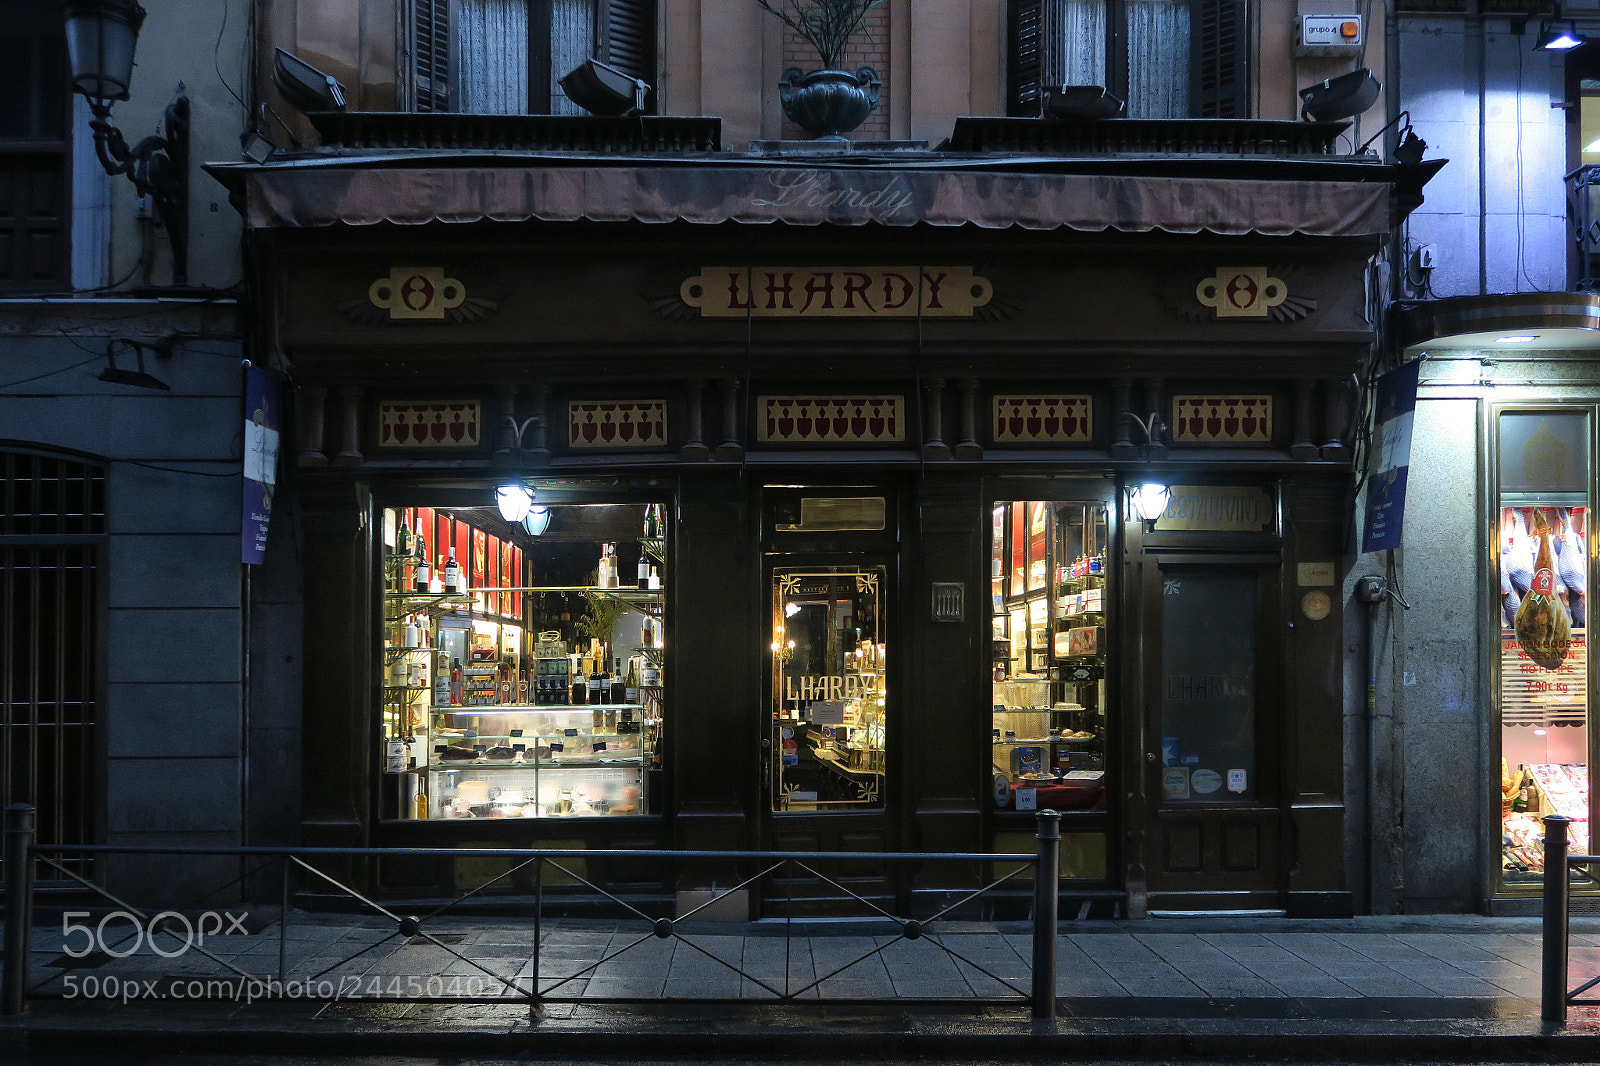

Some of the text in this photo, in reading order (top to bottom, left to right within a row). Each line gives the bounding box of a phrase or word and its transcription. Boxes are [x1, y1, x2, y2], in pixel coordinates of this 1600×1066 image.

[1308, 26, 1337, 35] grupo 4
[751, 168, 913, 220] Lhardy
[400, 274, 435, 312] 8
[727, 272, 948, 314] LHARDY
[1226, 273, 1258, 310] 8
[785, 675, 874, 701] LHARDY
